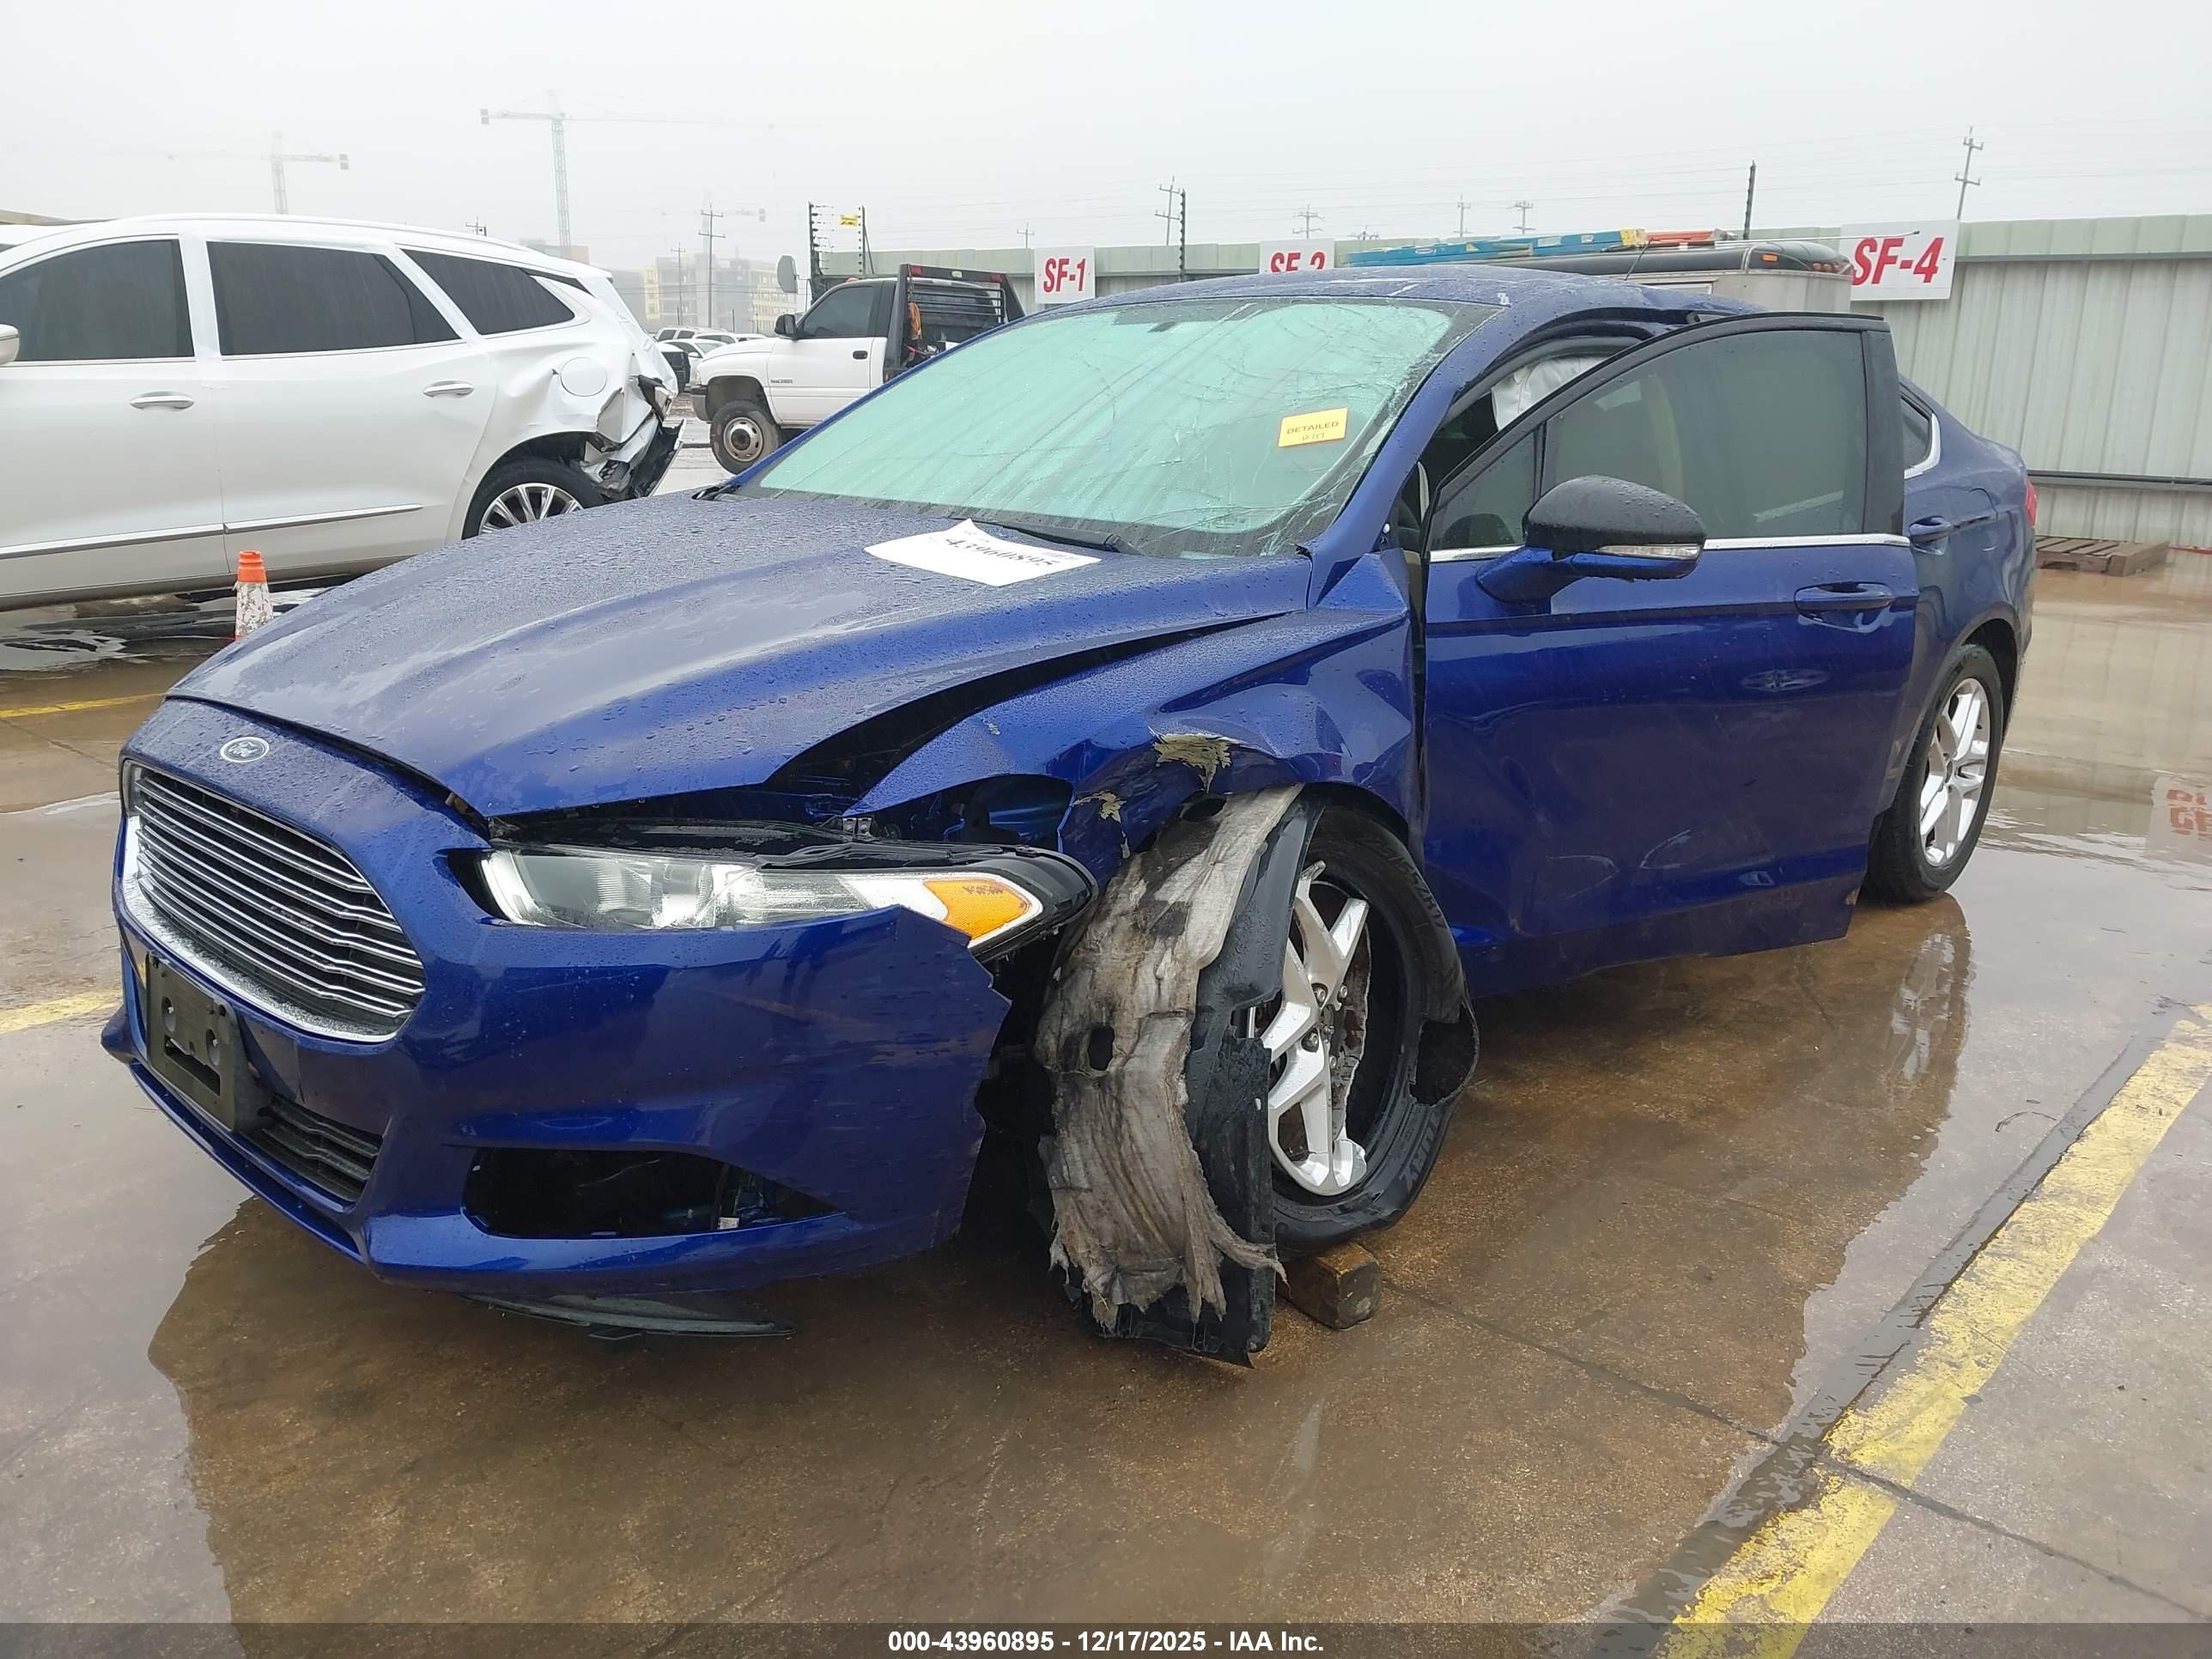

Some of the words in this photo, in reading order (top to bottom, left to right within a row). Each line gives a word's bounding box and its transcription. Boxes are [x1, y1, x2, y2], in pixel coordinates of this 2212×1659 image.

[1042, 258, 1085, 293] SF-1
[1852, 236, 1944, 285] SF-4
[1286, 421, 1340, 434] DETAILED
